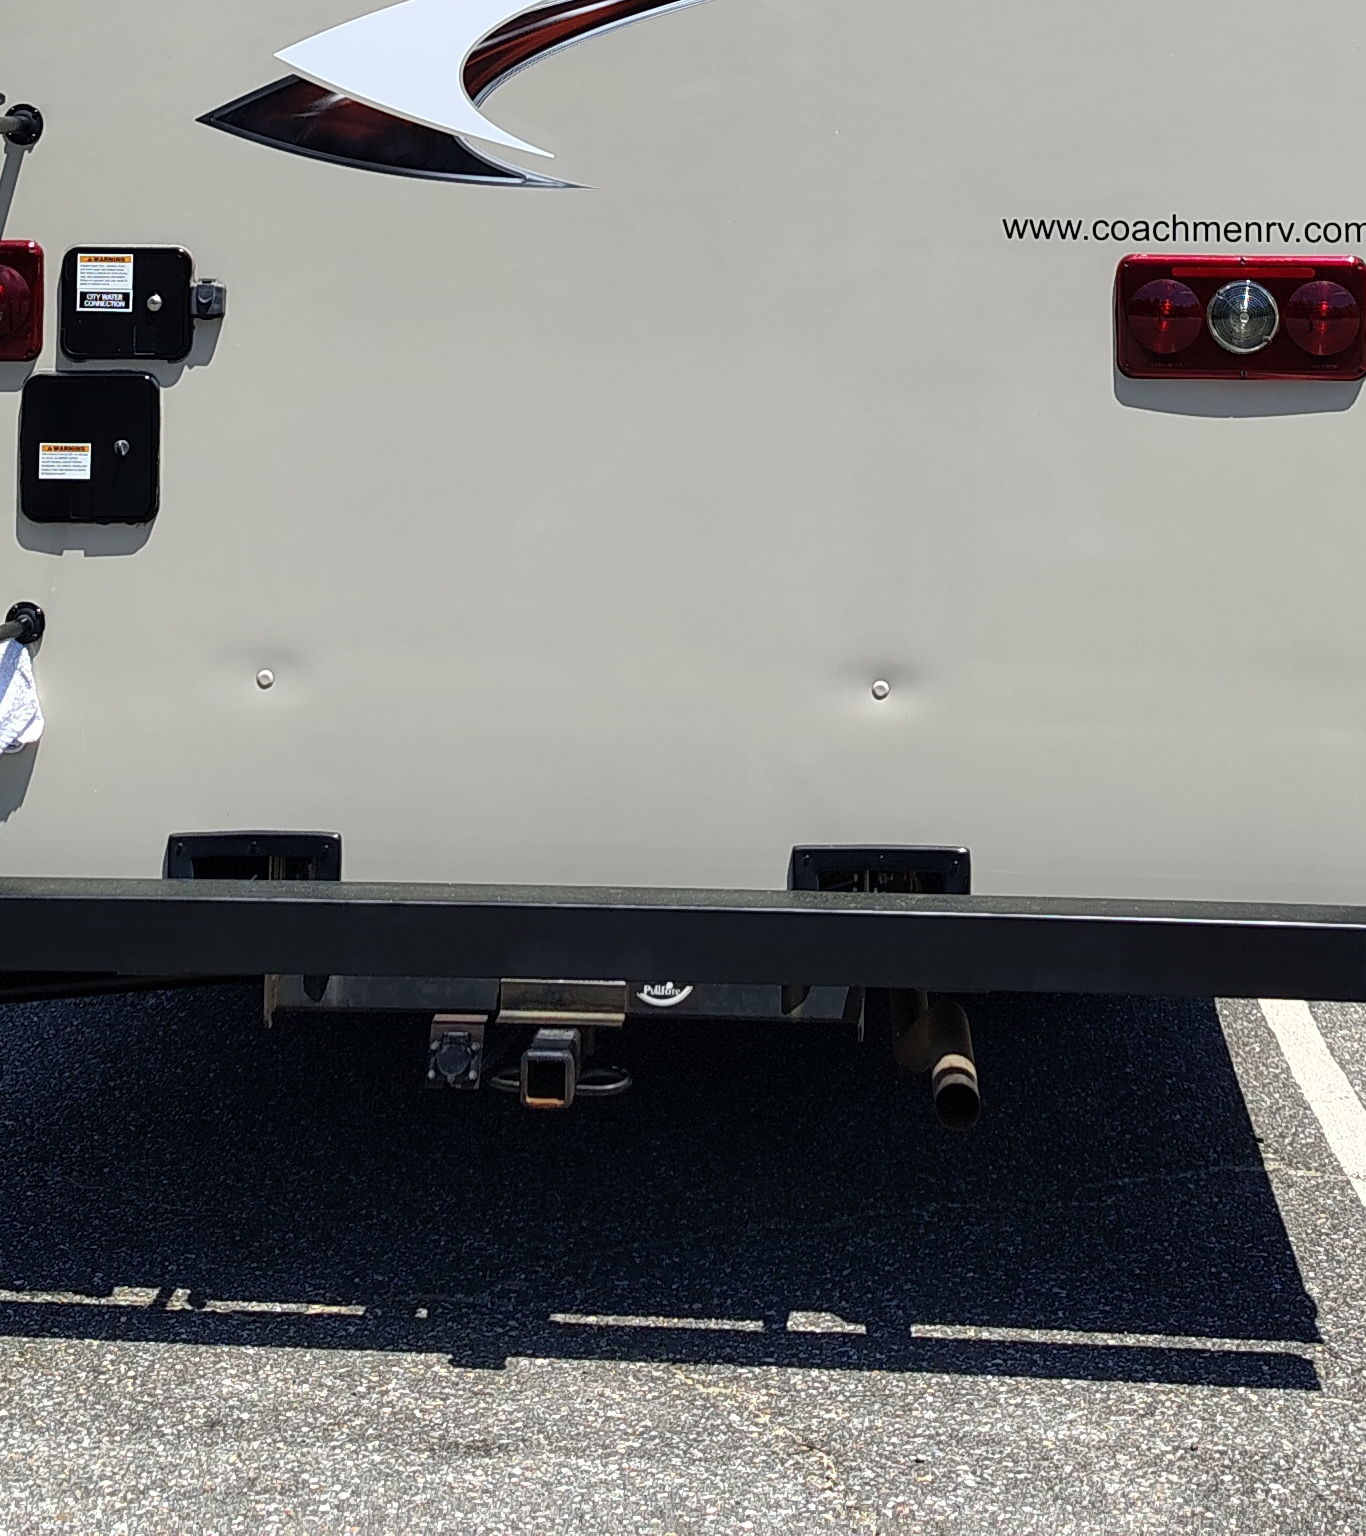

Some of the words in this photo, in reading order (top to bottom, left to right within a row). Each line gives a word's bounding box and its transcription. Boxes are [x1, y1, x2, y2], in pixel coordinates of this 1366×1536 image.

[86, 293, 101, 301] CITY
[101, 293, 123, 301] WATER
[83, 300, 126, 308] CONNECTION
